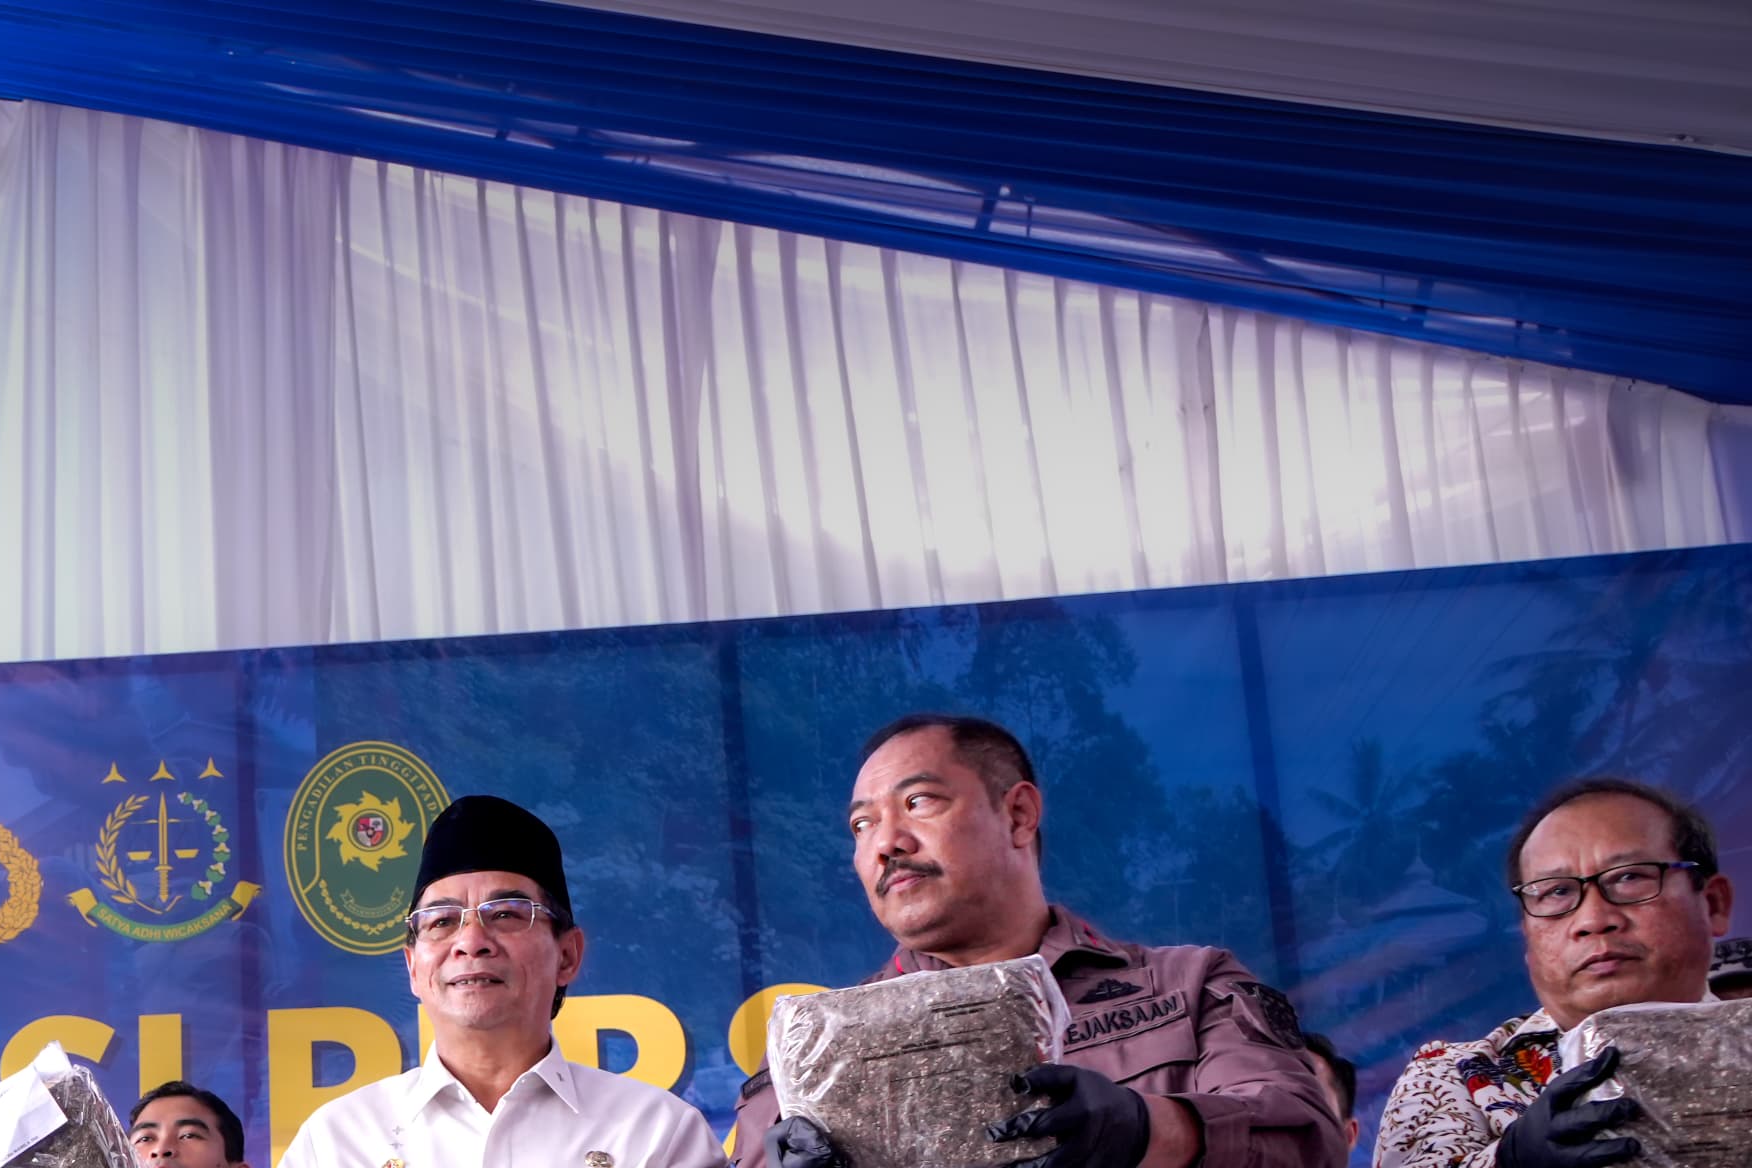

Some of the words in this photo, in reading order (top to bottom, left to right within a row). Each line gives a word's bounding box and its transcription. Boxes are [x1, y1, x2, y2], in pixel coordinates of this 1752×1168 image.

[296, 759, 354, 852] PENGADILAN
[359, 754, 418, 784] TINGGI
[97, 907, 131, 935] SATYA
[132, 928, 162, 939] ADHI
[163, 904, 233, 939] WICAKSANA
[1064, 995, 1178, 1045] EJAKSAAN
